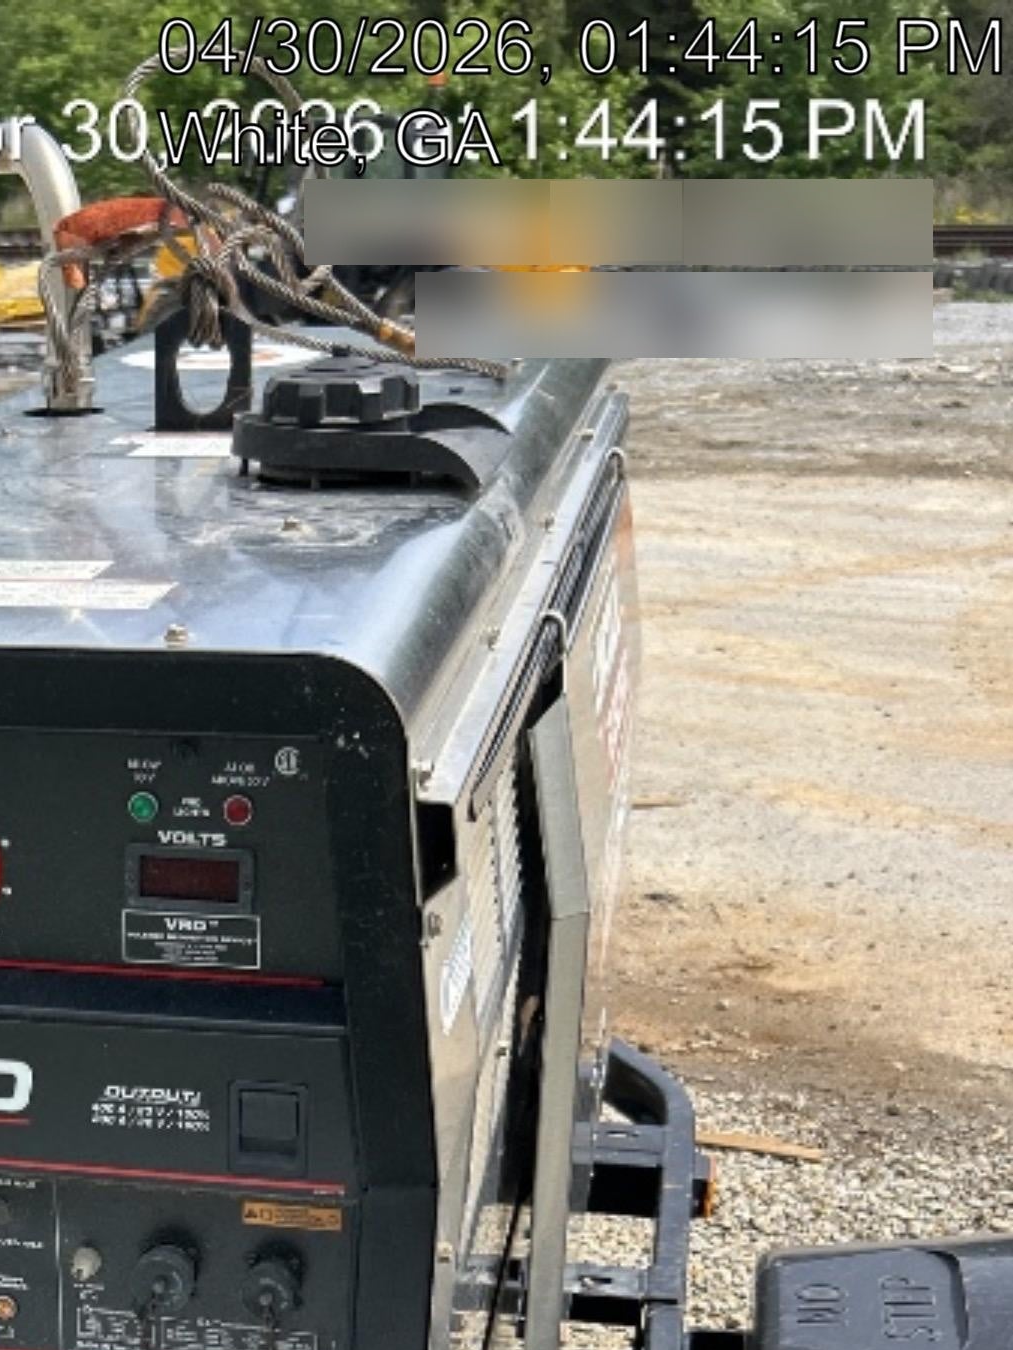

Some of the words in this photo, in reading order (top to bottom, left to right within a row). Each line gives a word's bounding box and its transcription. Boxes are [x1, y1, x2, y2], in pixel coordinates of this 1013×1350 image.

[157, 830, 228, 847] VOLTS
[794, 1283, 849, 1325] NO
[879, 1276, 941, 1342] STEP
